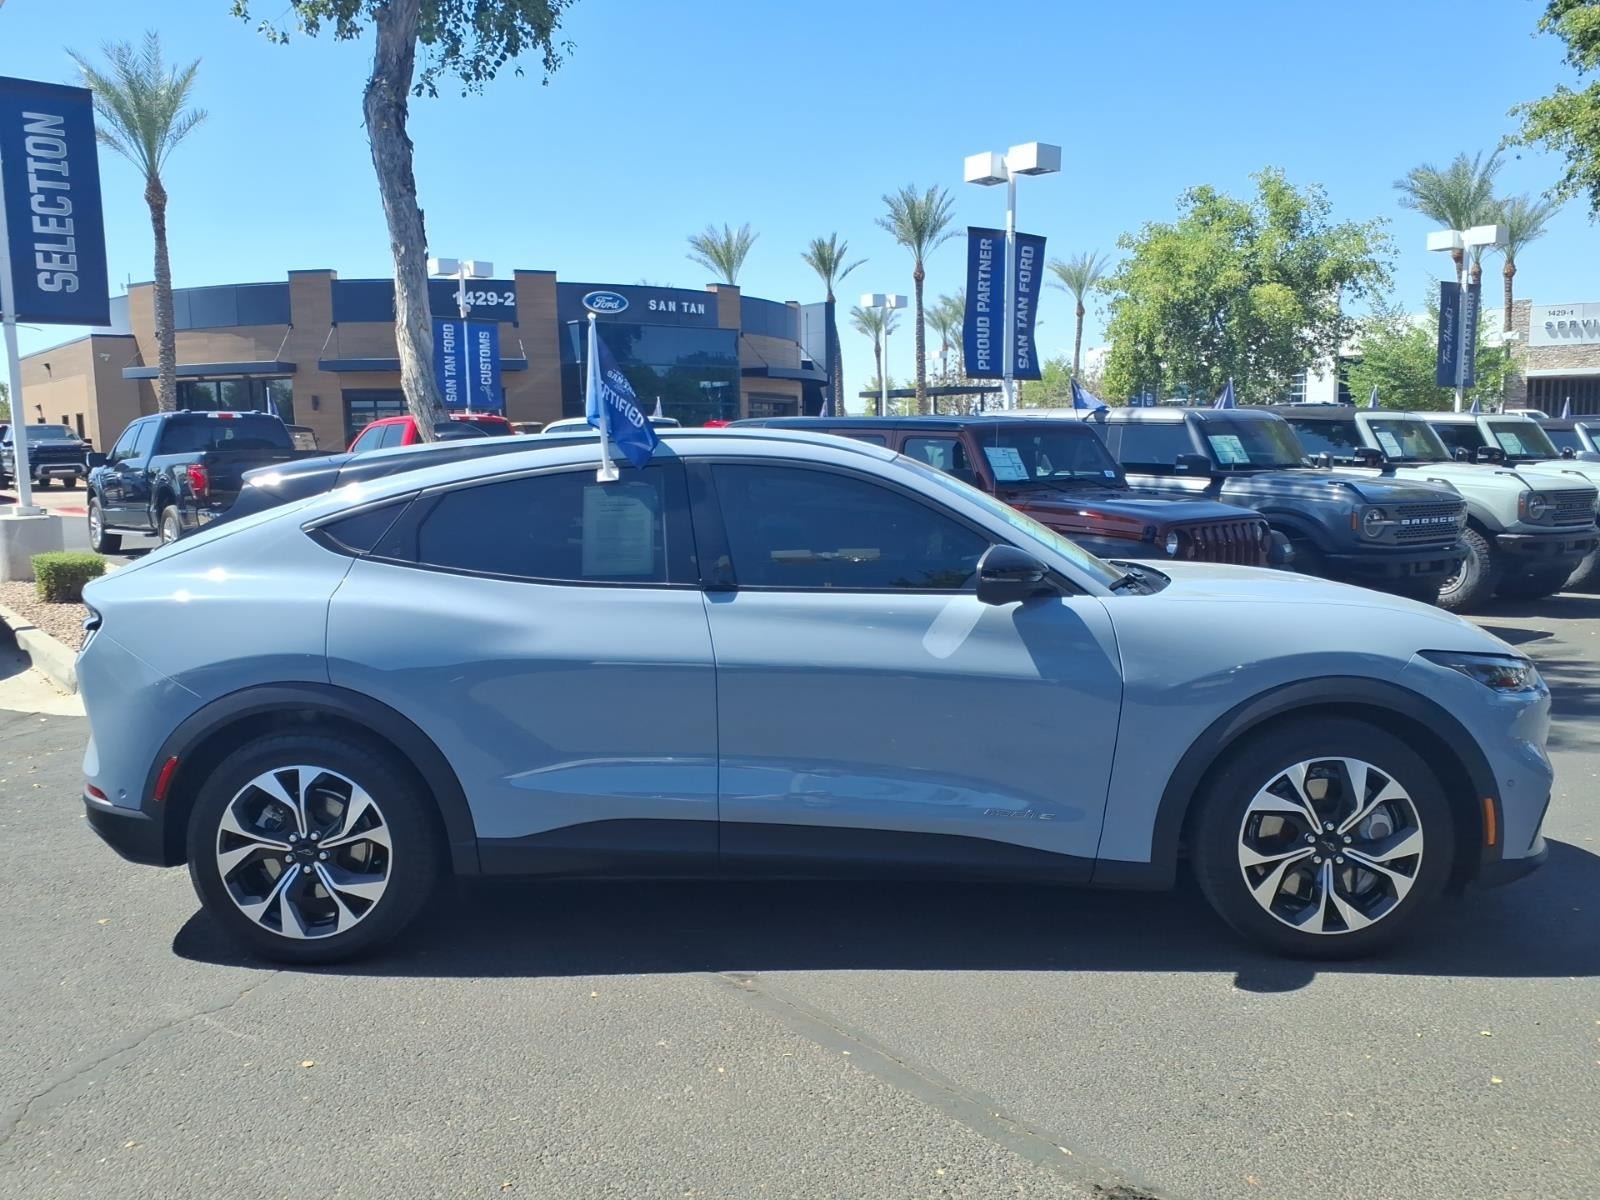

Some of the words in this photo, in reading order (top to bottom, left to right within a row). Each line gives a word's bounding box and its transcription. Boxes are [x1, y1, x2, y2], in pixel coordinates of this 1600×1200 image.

[22, 111, 79, 294] SELECTION
[976, 238, 993, 313] PARTNER
[1018, 245, 1034, 293] FORD
[452, 291, 516, 306] 1429-2
[648, 299, 676, 312] SAN
[682, 302, 705, 314] TAN
[1016, 297, 1030, 328] TAN
[442, 323, 455, 354] FORD
[976, 316, 991, 371] PROUD
[1018, 335, 1030, 369] SAN
[444, 355, 456, 377] TAN
[479, 331, 492, 385] CUSTOMS
[445, 379, 457, 402] SAN
[1400, 516, 1455, 525] BRONCO
